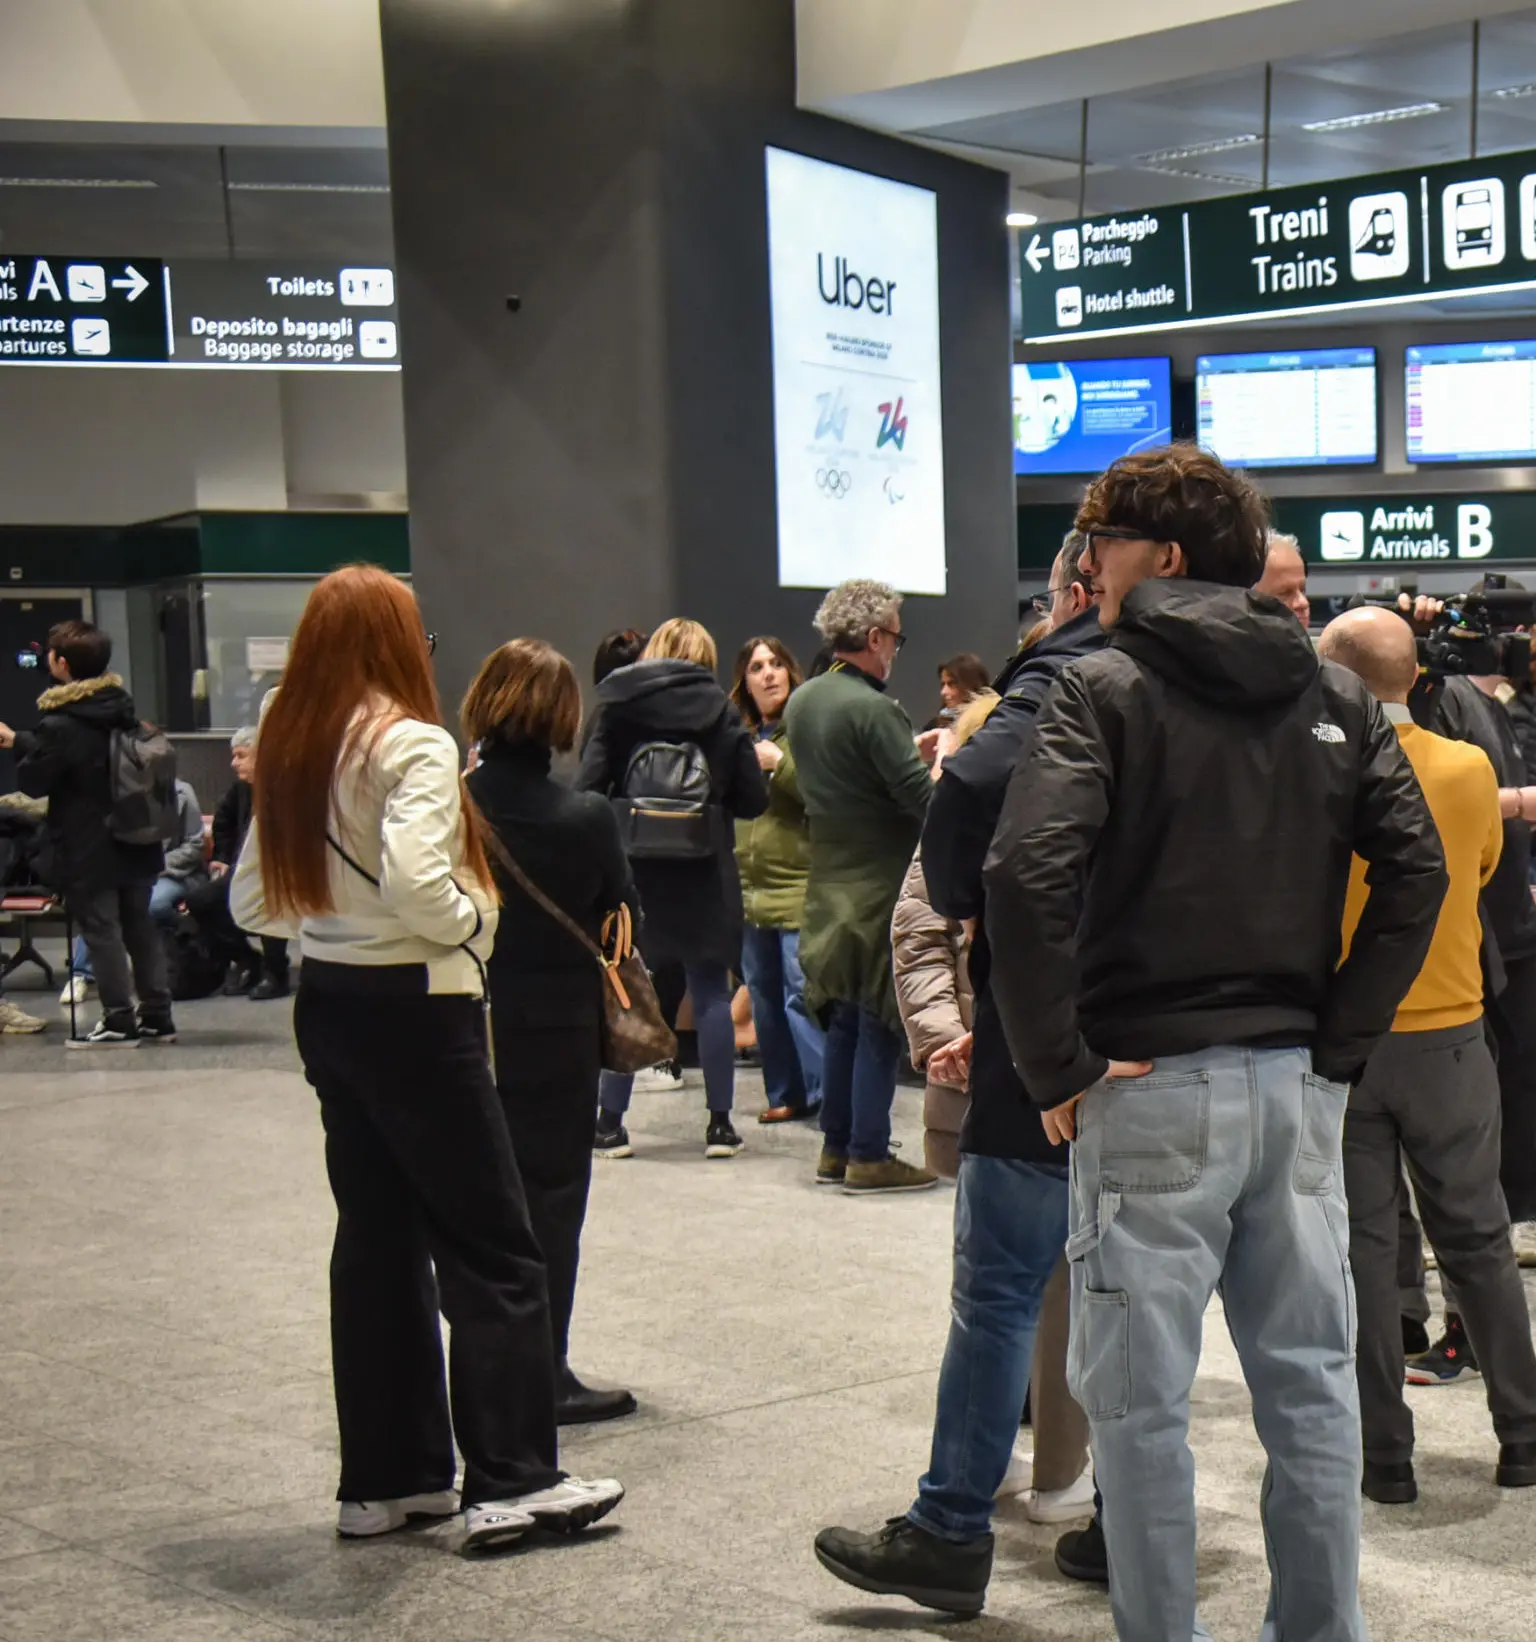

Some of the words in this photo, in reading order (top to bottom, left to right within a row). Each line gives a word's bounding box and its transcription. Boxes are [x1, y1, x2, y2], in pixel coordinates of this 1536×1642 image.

[1082, 214, 1158, 244] Parcheggio
[1249, 196, 1329, 245] Treni
[1083, 243, 1133, 267] Parking
[27, 259, 62, 301] A
[817, 251, 898, 316] Uber
[1251, 252, 1338, 294] Trains
[266, 277, 335, 297] Toilets
[1085, 289, 1123, 314] Hotel
[1125, 284, 1175, 309] shuttle
[0, 316, 65, 333] rtenze
[191, 316, 278, 337] Deposito
[282, 317, 353, 338] bagagli
[0, 338, 67, 355] artures
[204, 337, 283, 361] Baggage
[288, 339, 354, 362] storage
[1369, 505, 1434, 531] Arrivi
[1457, 503, 1494, 559] B
[1370, 533, 1450, 559] Arrivals
